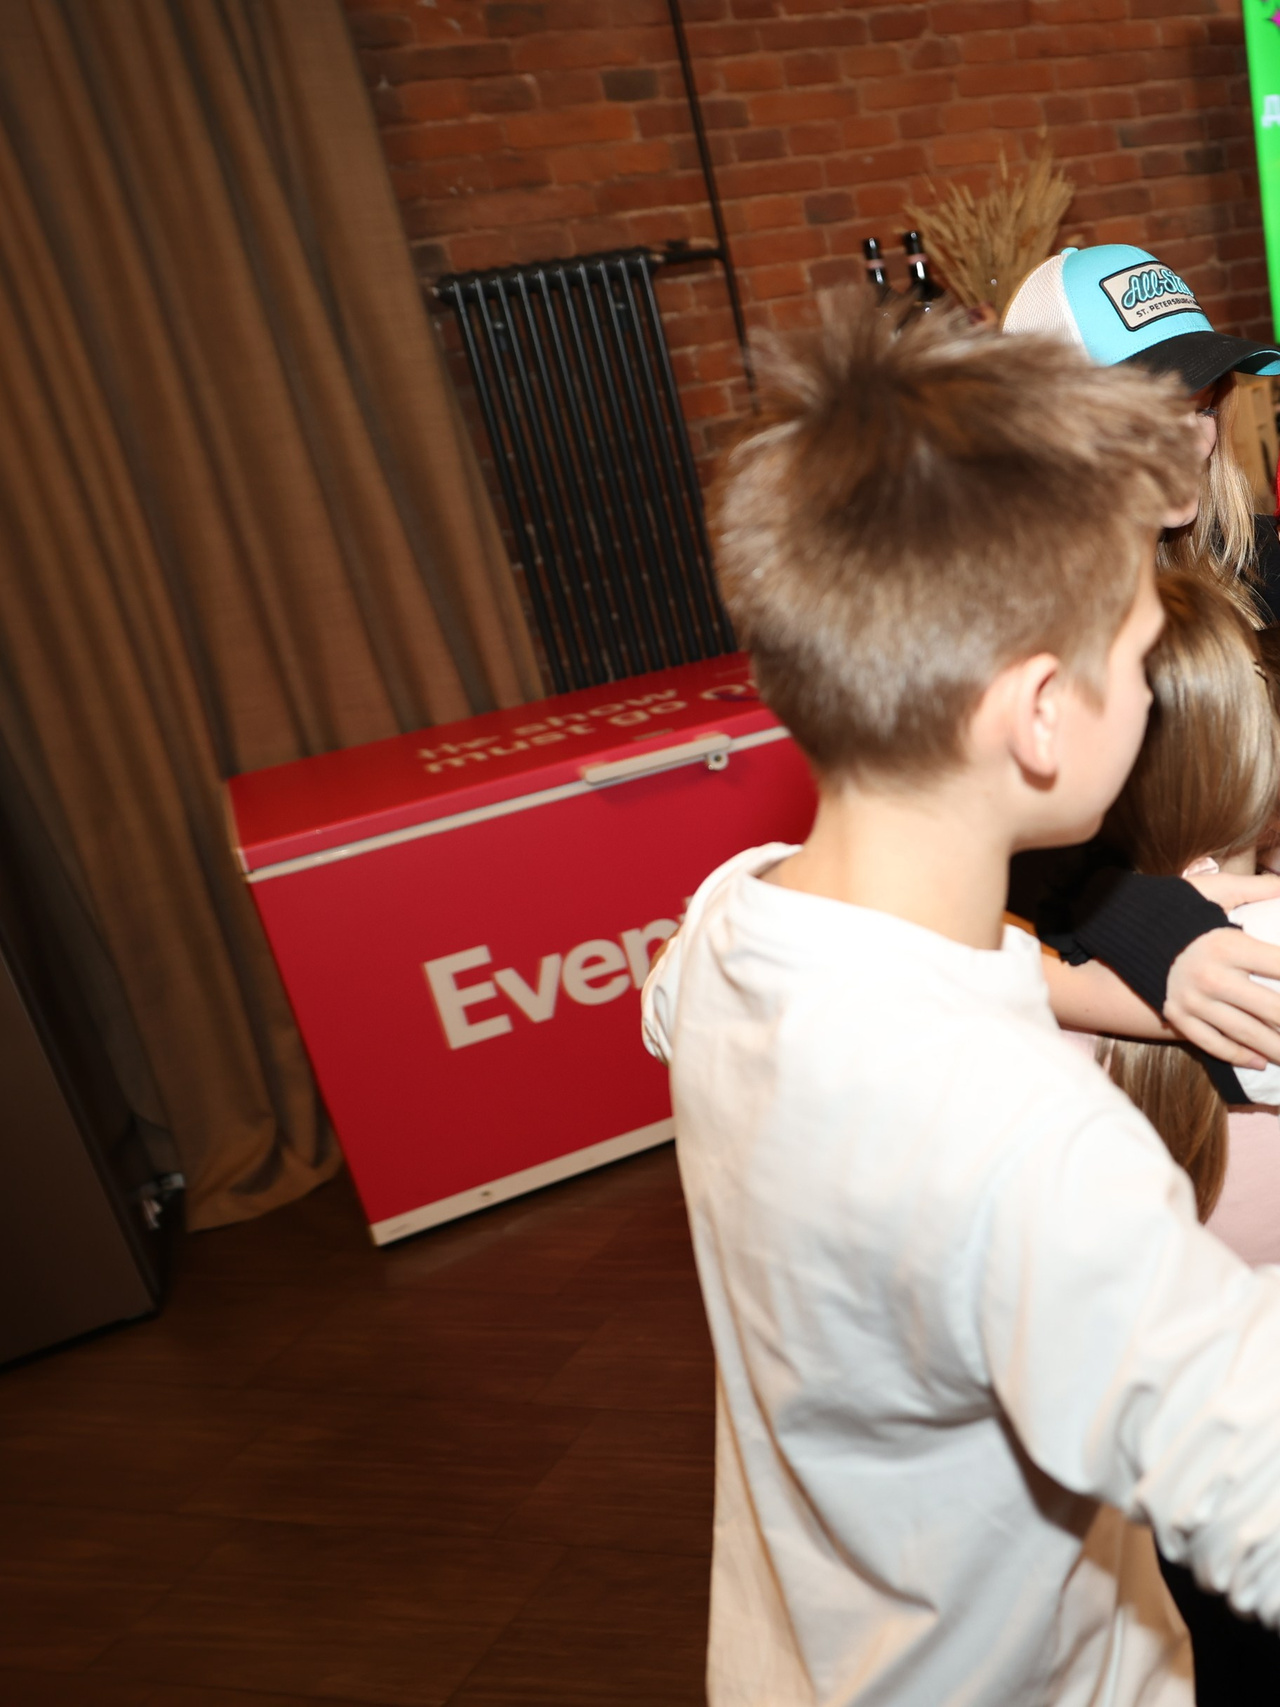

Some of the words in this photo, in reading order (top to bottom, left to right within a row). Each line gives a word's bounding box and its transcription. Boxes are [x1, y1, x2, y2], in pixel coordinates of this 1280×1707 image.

[424, 723, 597, 774] must
[607, 700, 688, 728] go
[511, 688, 678, 735] show
[422, 895, 694, 1051] Even
